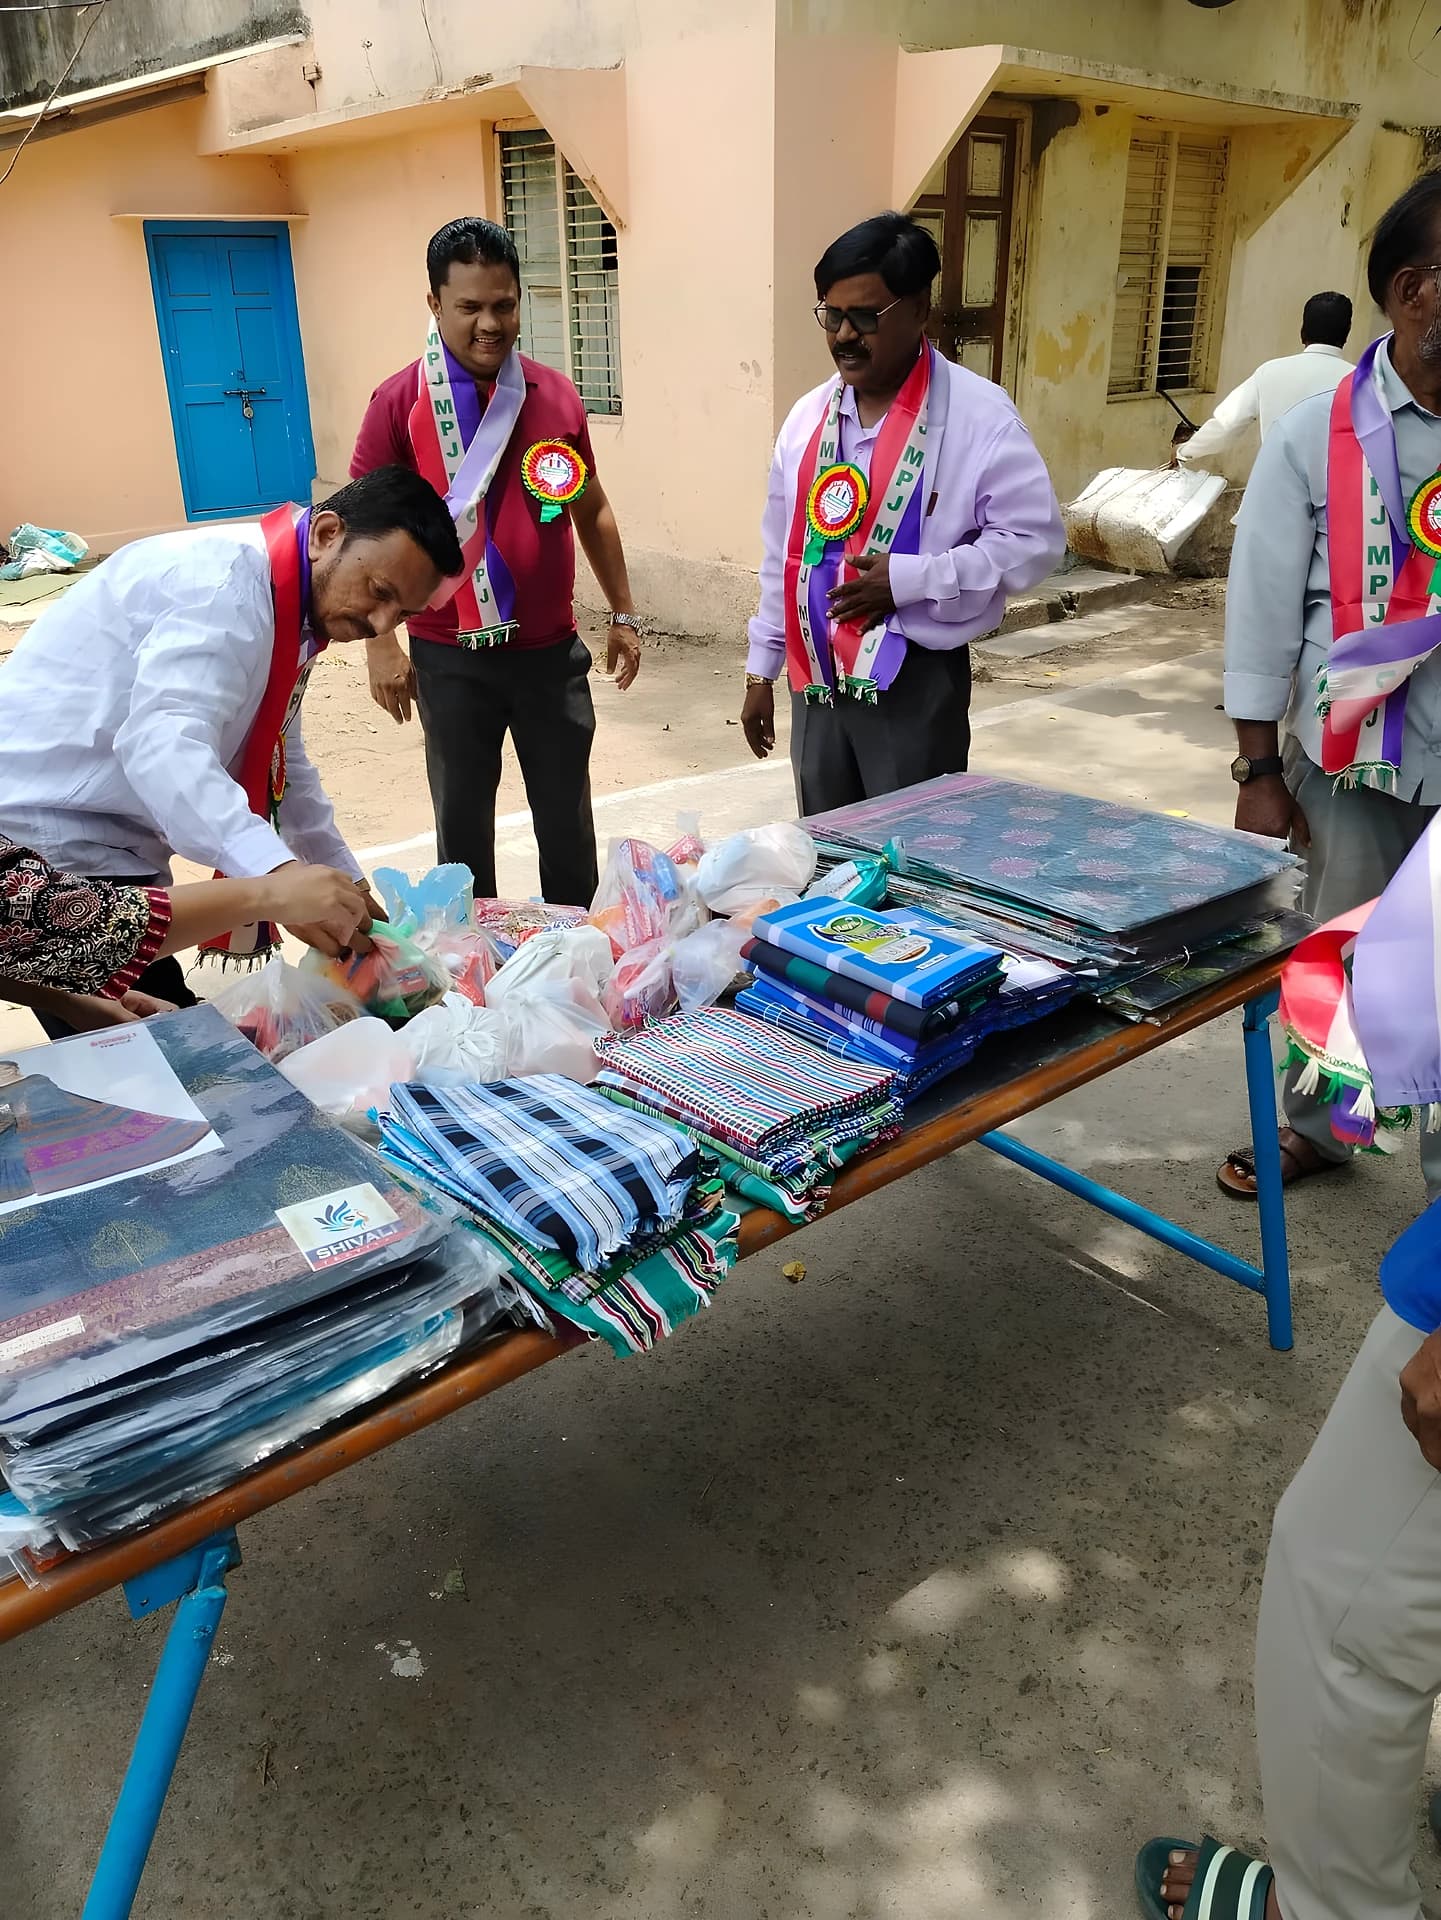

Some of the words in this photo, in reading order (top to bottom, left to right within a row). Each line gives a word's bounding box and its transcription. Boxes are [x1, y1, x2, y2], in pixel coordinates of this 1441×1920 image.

[434, 399, 459, 458] MPJ
[886, 445, 925, 512] MPJ
[1367, 545, 1391, 623] MPJ
[316, 1224, 399, 1260] SHIVALI
